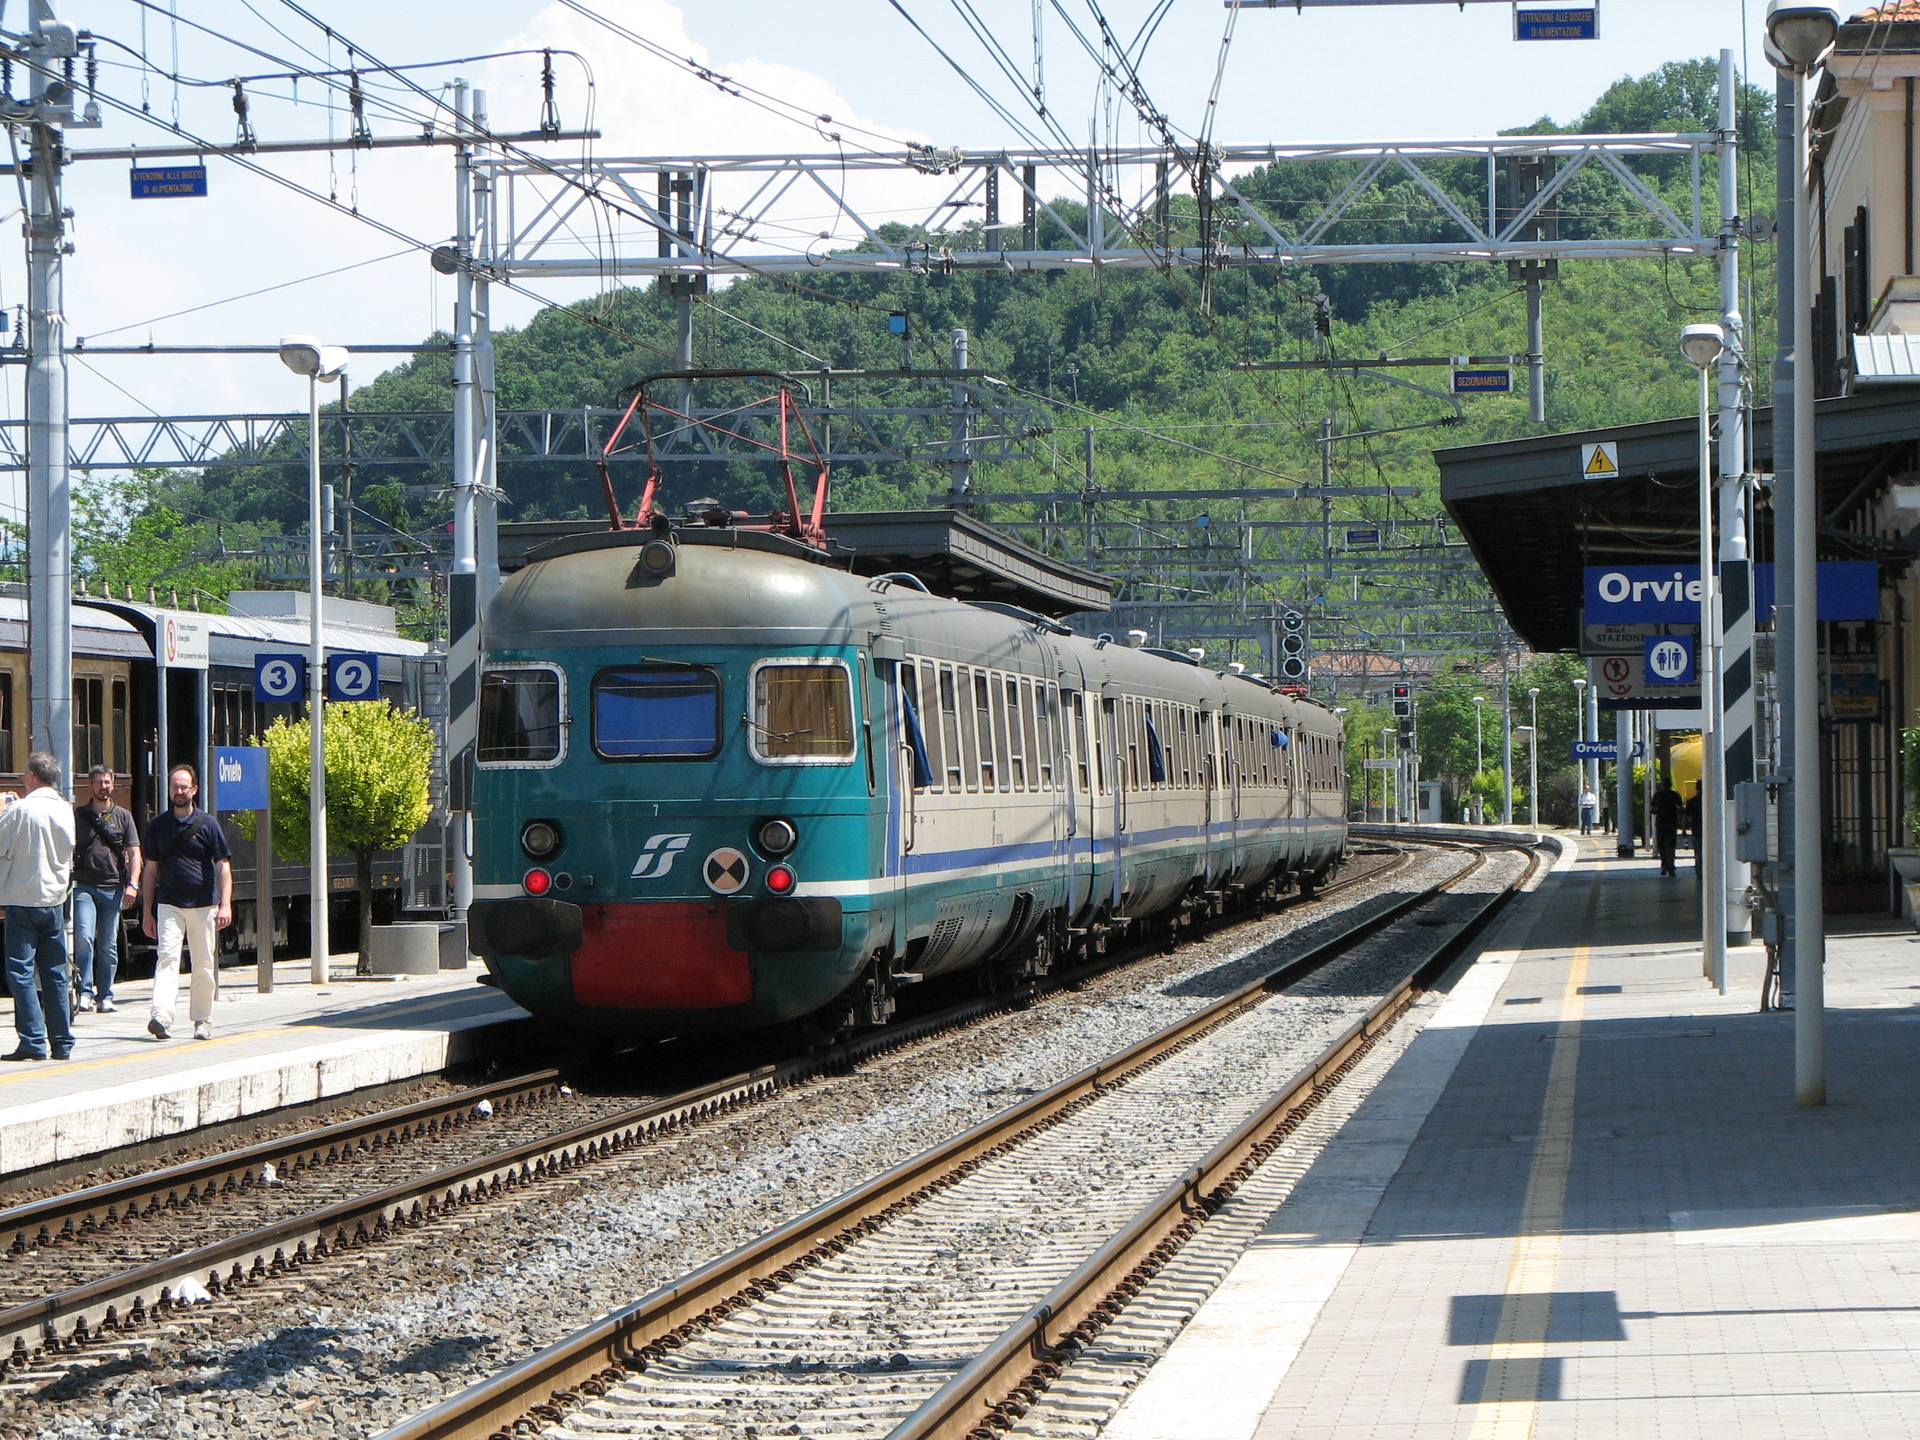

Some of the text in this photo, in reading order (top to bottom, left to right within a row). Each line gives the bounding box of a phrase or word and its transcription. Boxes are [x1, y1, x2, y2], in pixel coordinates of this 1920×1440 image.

[1556, 12, 1568, 22] ALLE
[166, 170, 180, 181] ALLE
[1457, 375, 1507, 387] SEZIONAMENTO
[1598, 571, 1719, 602] Orvie
[269, 666, 288, 690] 3
[344, 666, 363, 690] 2
[219, 756, 242, 783] Orvieto
